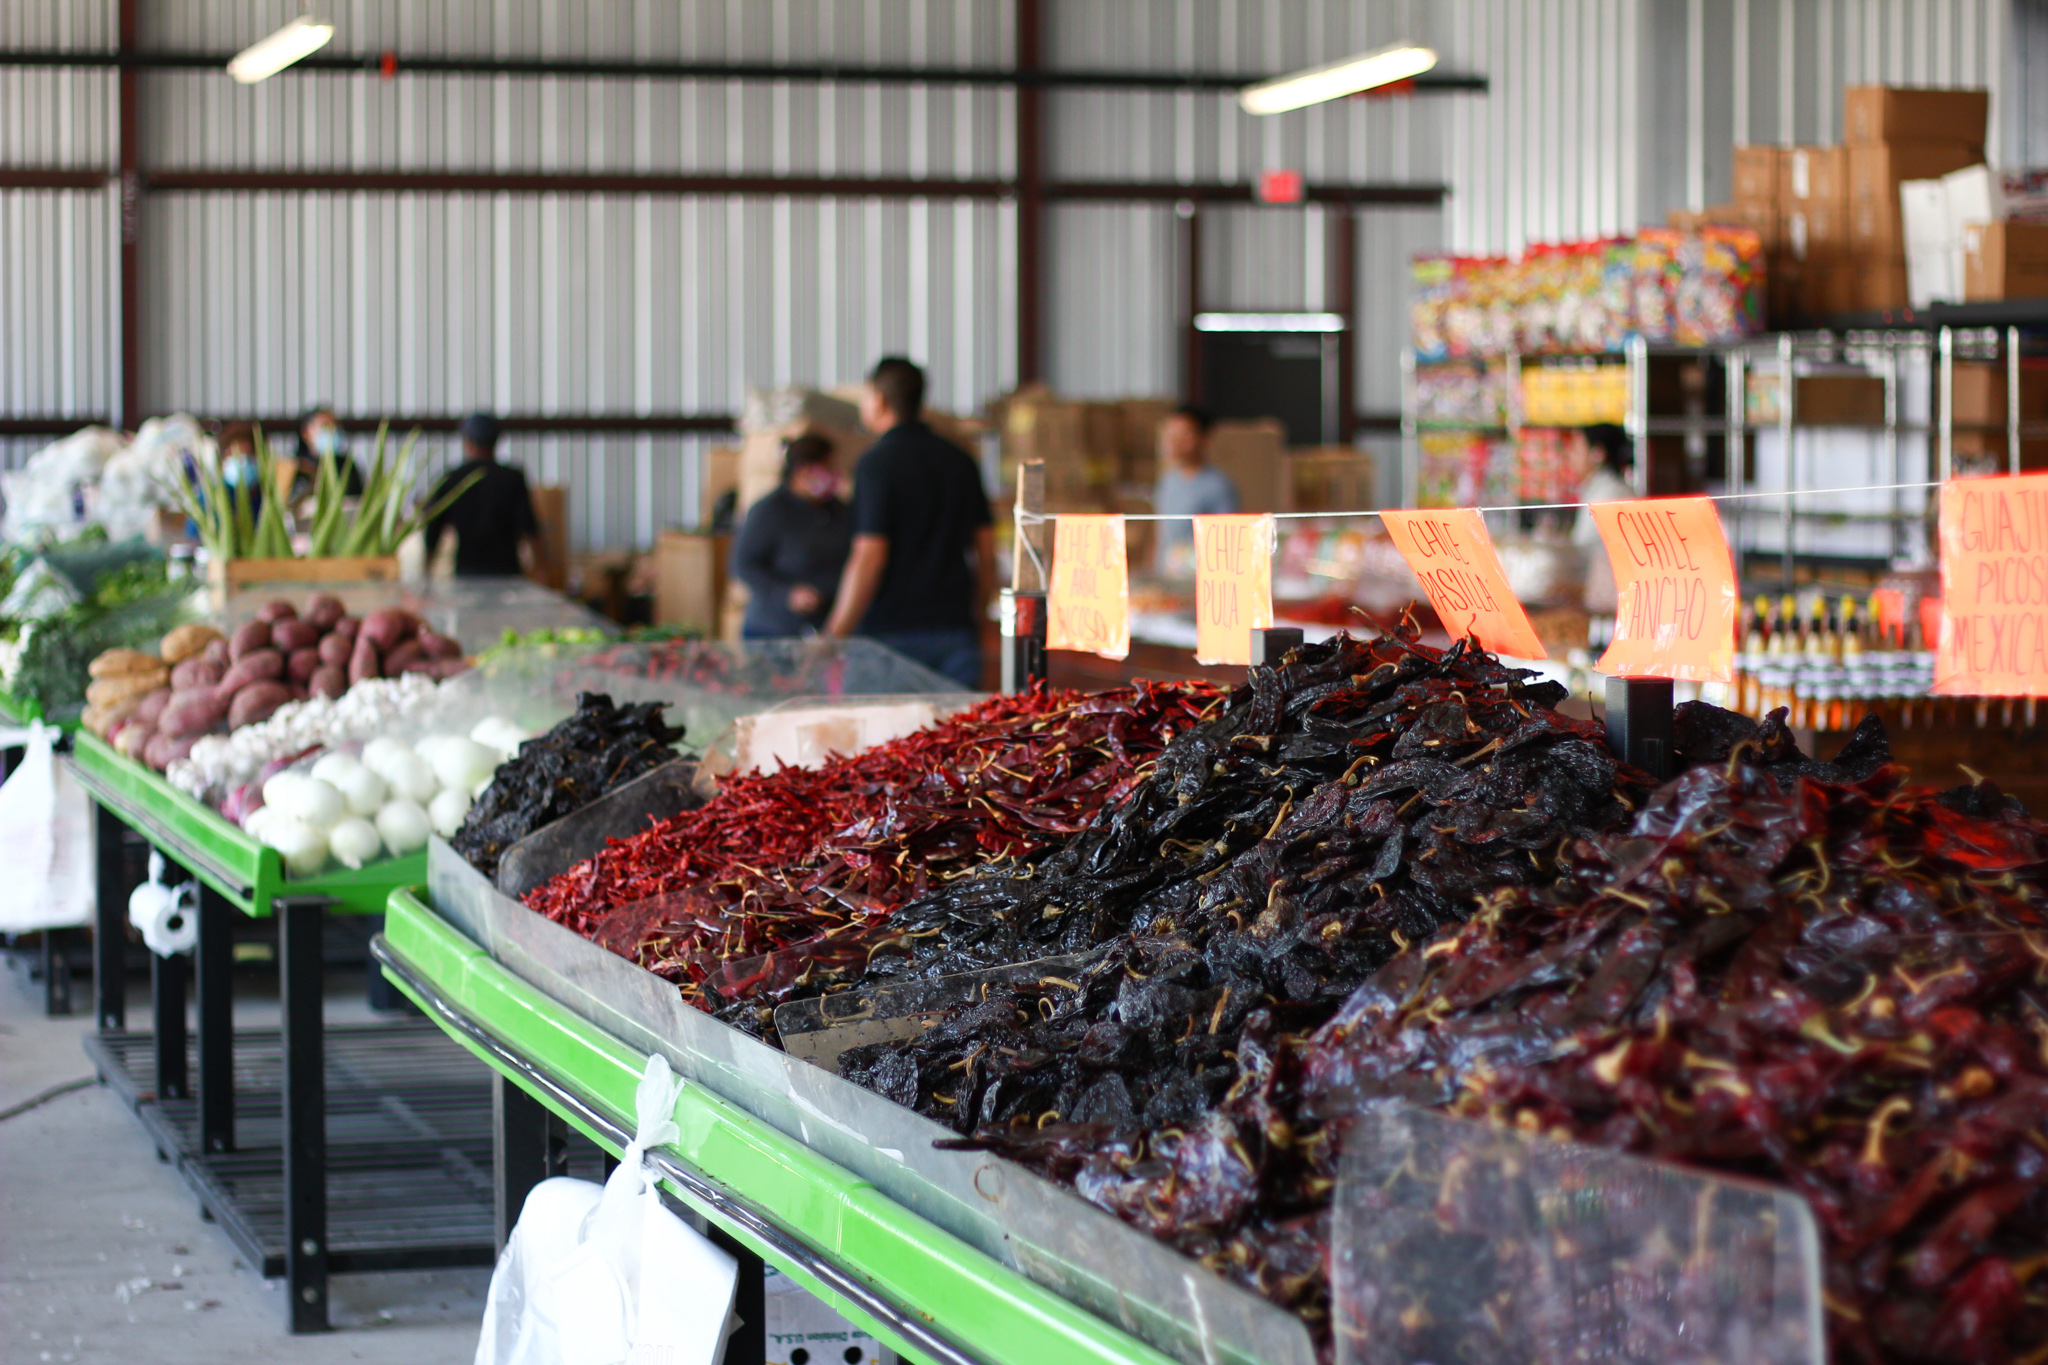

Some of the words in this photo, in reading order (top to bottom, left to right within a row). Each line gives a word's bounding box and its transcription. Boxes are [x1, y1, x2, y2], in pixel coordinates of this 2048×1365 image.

[1205, 523, 1248, 575] CHILE
[1407, 519, 1470, 565] CHILE
[1617, 510, 1700, 572] CHILE
[1416, 568, 1500, 613] PASILLA
[1976, 555, 2048, 606] PICOS
[1629, 576, 1707, 640] ANCHO
